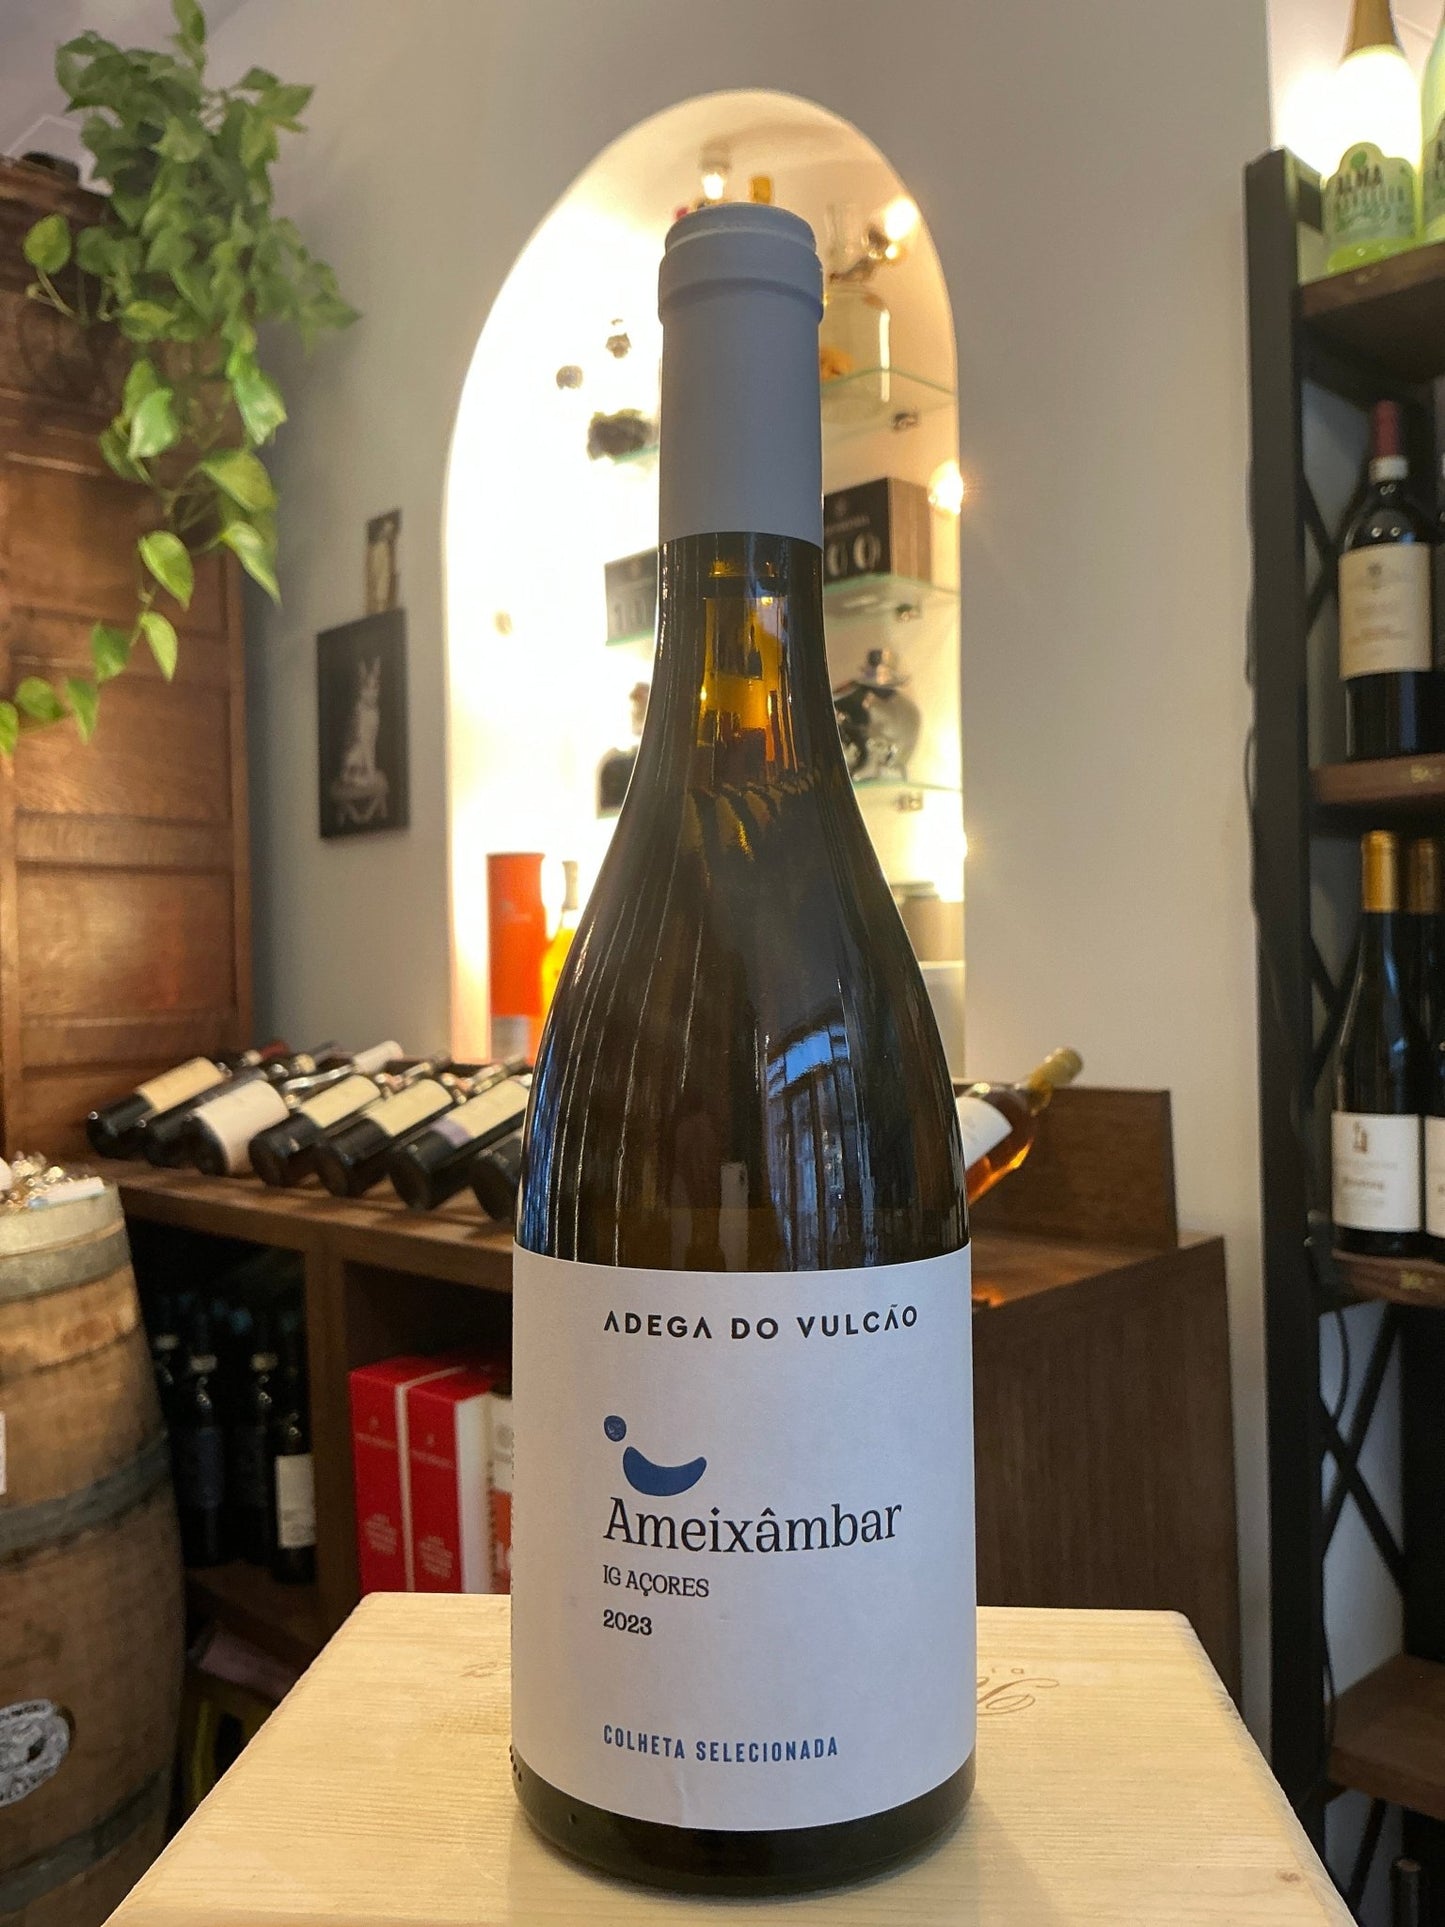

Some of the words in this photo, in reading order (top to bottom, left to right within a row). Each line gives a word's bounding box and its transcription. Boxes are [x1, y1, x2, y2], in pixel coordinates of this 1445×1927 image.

[604, 1310, 712, 1339] ADEGA
[731, 1318, 778, 1339] DO
[796, 1304, 917, 1338] VULCÃO
[603, 1497, 902, 1553] Ameixâmbar
[603, 1565, 621, 1586] IG
[625, 1570, 709, 1597] AÇORES
[603, 1609, 652, 1636] 2023
[604, 1725, 685, 1759] COLHETA
[696, 1737, 837, 1762] SELECIONADA
